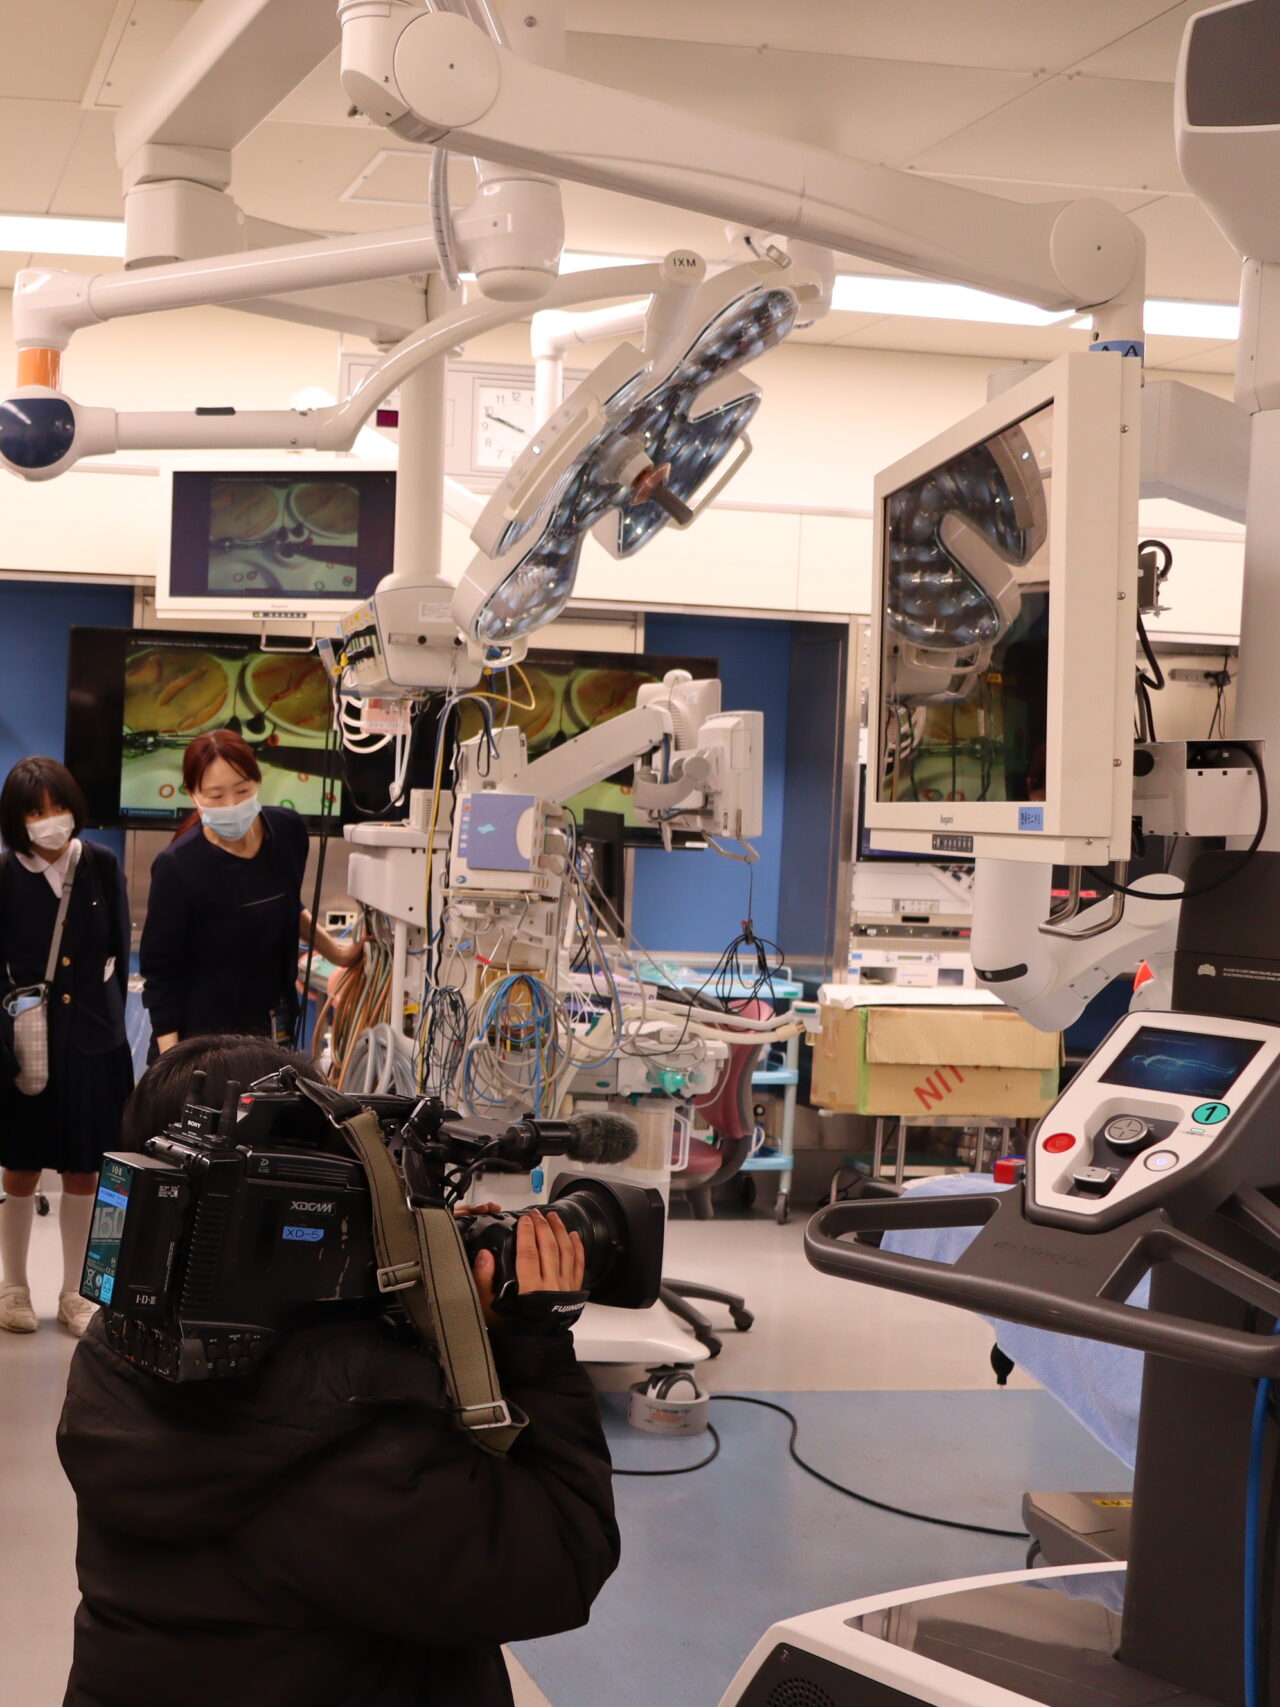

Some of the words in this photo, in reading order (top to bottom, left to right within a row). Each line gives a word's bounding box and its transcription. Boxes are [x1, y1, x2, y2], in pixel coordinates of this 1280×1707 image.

[496, 394, 505, 405] 11
[511, 391, 521, 402] 12
[484, 438, 492, 448] 8
[496, 449, 504, 460] 7
[913, 1064, 981, 1112] NIT
[1202, 1105, 1218, 1122] 1
[187, 1120, 201, 1128] SONY
[290, 1200, 333, 1213] XDCAM
[286, 1228, 320, 1240] XD-5
